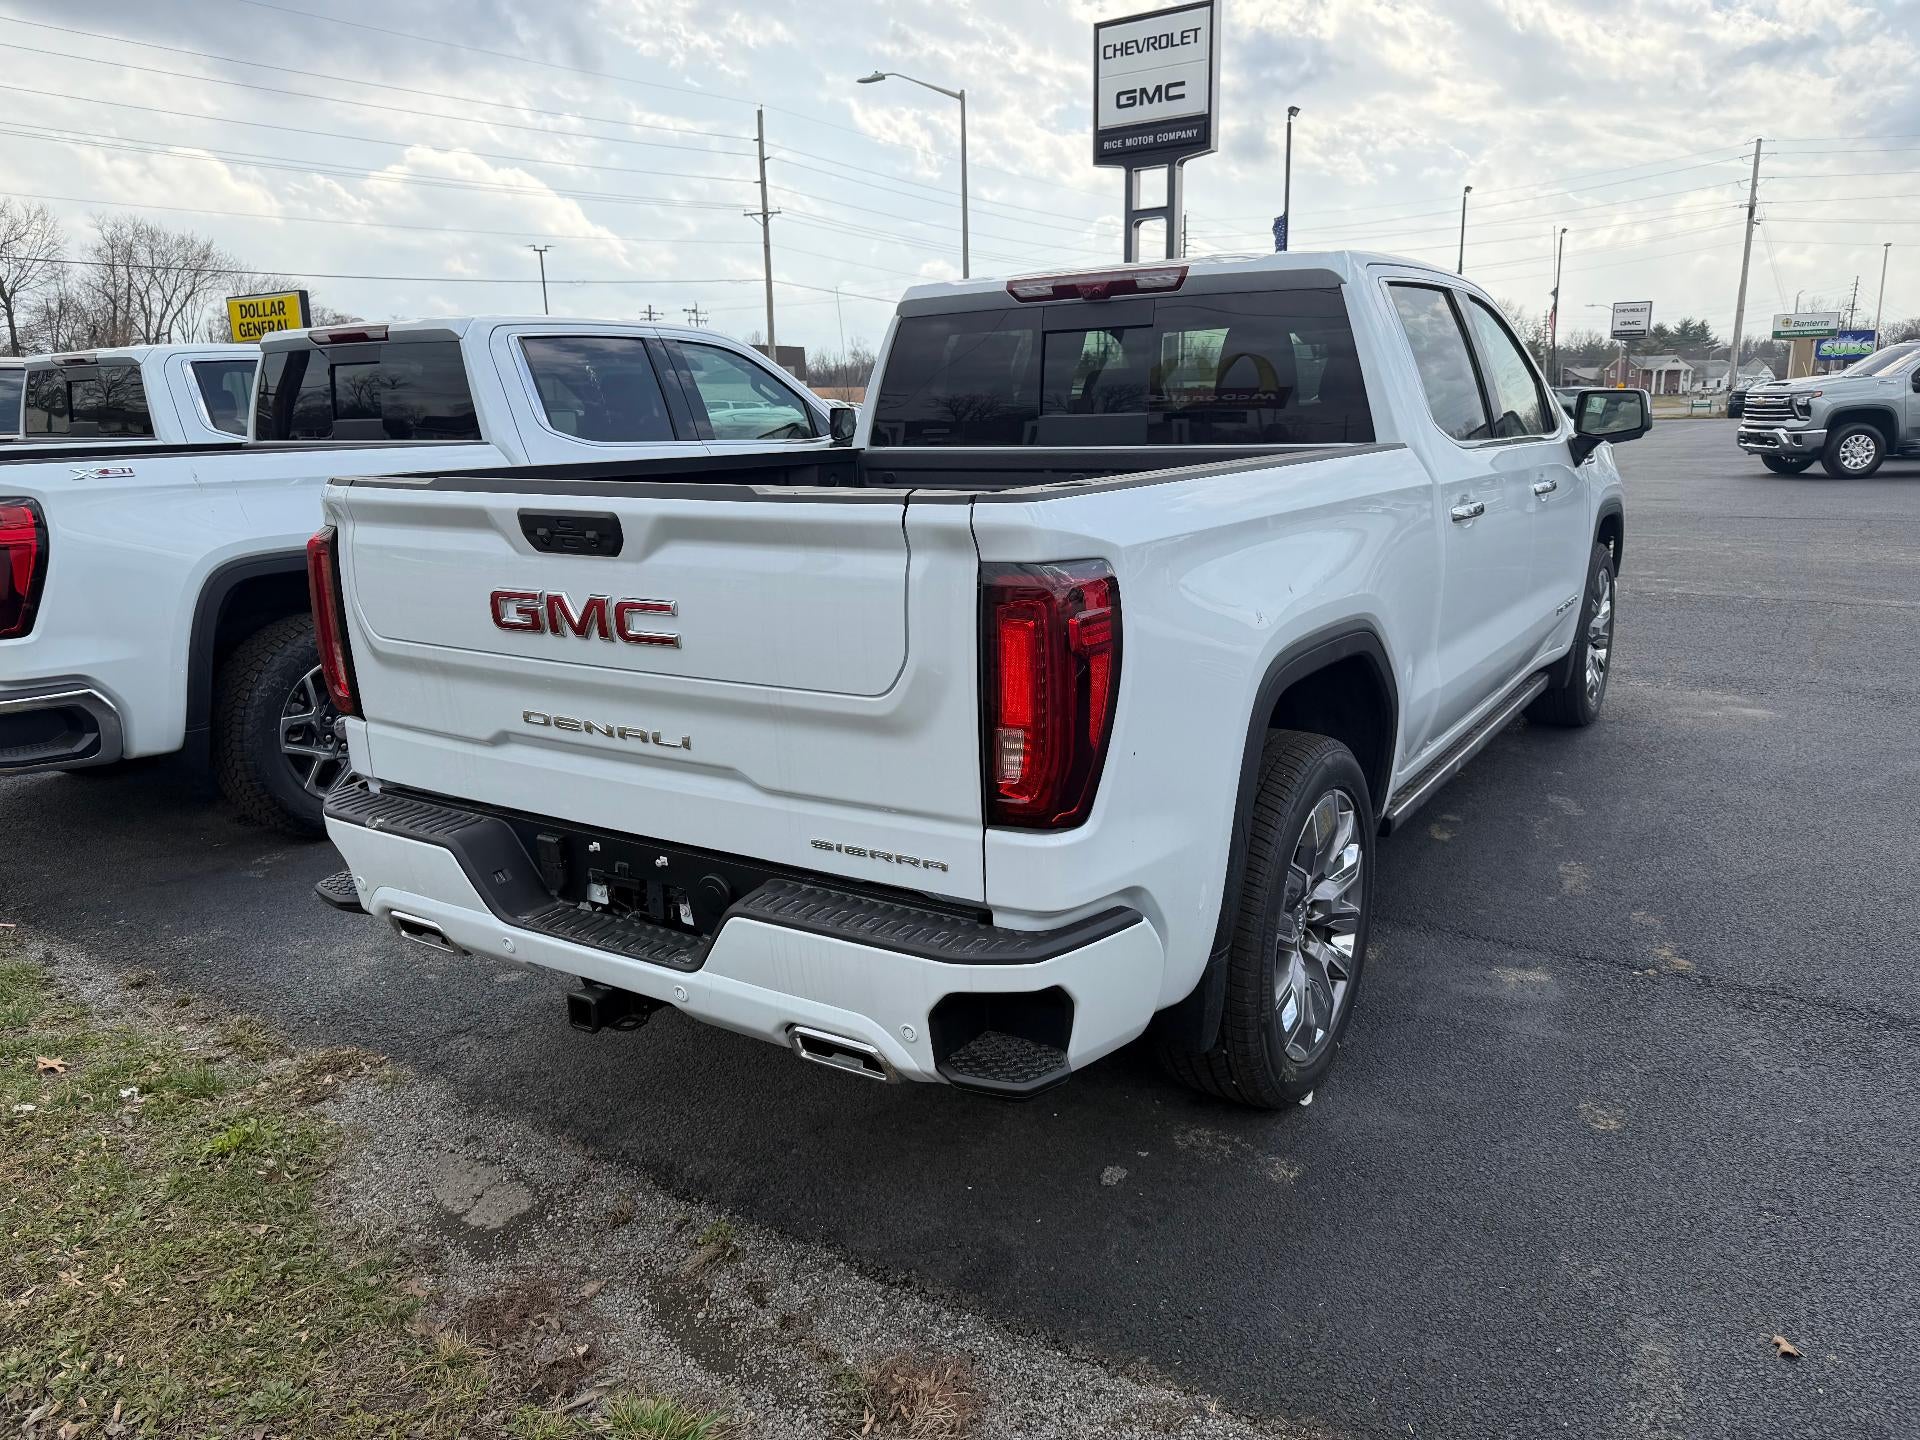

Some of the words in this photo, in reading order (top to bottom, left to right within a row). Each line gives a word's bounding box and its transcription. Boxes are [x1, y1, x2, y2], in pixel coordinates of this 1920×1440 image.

[1103, 27, 1202, 60] CHEVROLET
[1115, 81, 1186, 110] GMC
[1103, 139, 1123, 150] RICE
[1125, 135, 1154, 147] MOTOR
[1156, 128, 1198, 143] COMPANY
[239, 301, 287, 319] DOLLAR
[1793, 319, 1830, 328] Banterra
[1819, 341, 1874, 355] SUDS
[490, 587, 682, 649] GMC
[522, 710, 692, 750] DENALI
[810, 839, 949, 872] SIERRA
